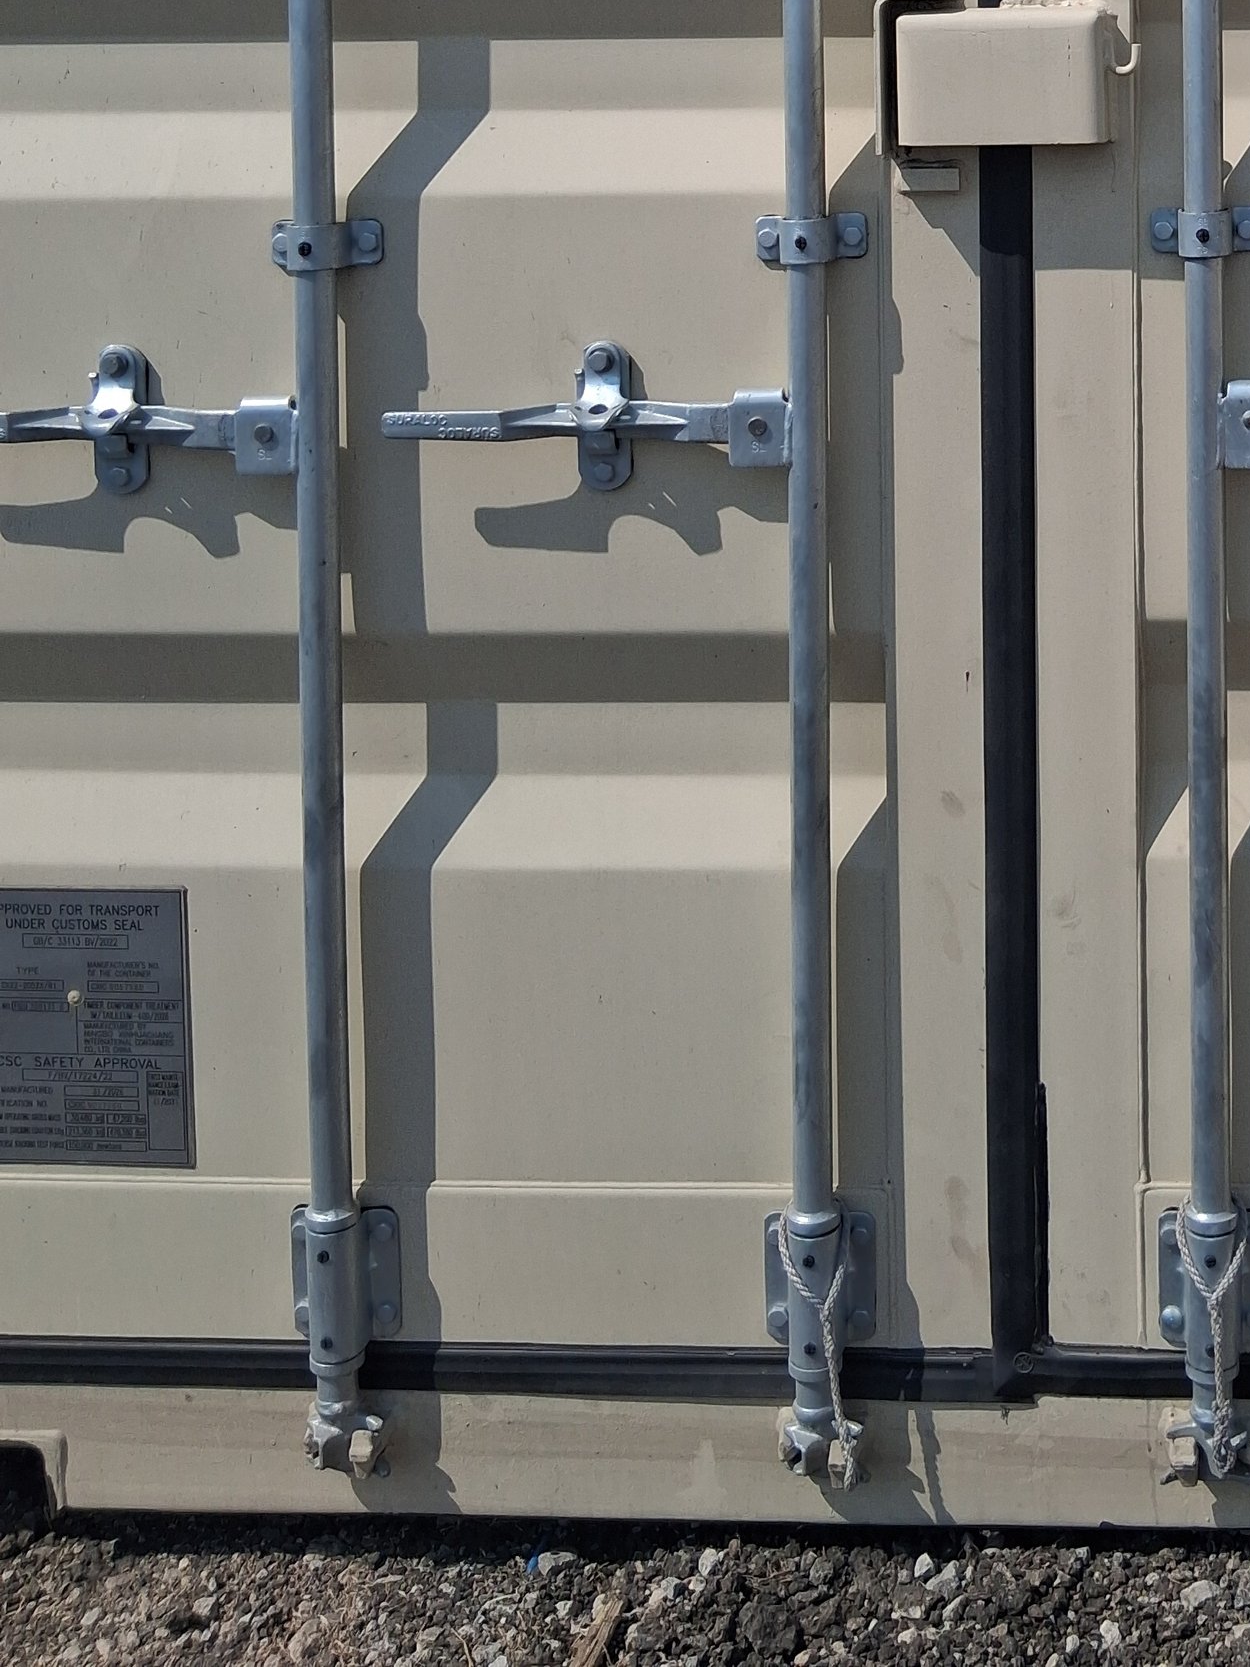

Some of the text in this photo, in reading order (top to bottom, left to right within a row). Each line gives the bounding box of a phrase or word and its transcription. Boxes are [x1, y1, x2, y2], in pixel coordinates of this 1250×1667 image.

[60, 905, 83, 916] FOR
[89, 905, 160, 917] TRANSPORT
[6, 918, 143, 931] UNDER CUSTOMS SEAL
[34, 1056, 84, 1068] SAFETY
[94, 1058, 162, 1070] APPROVAL
